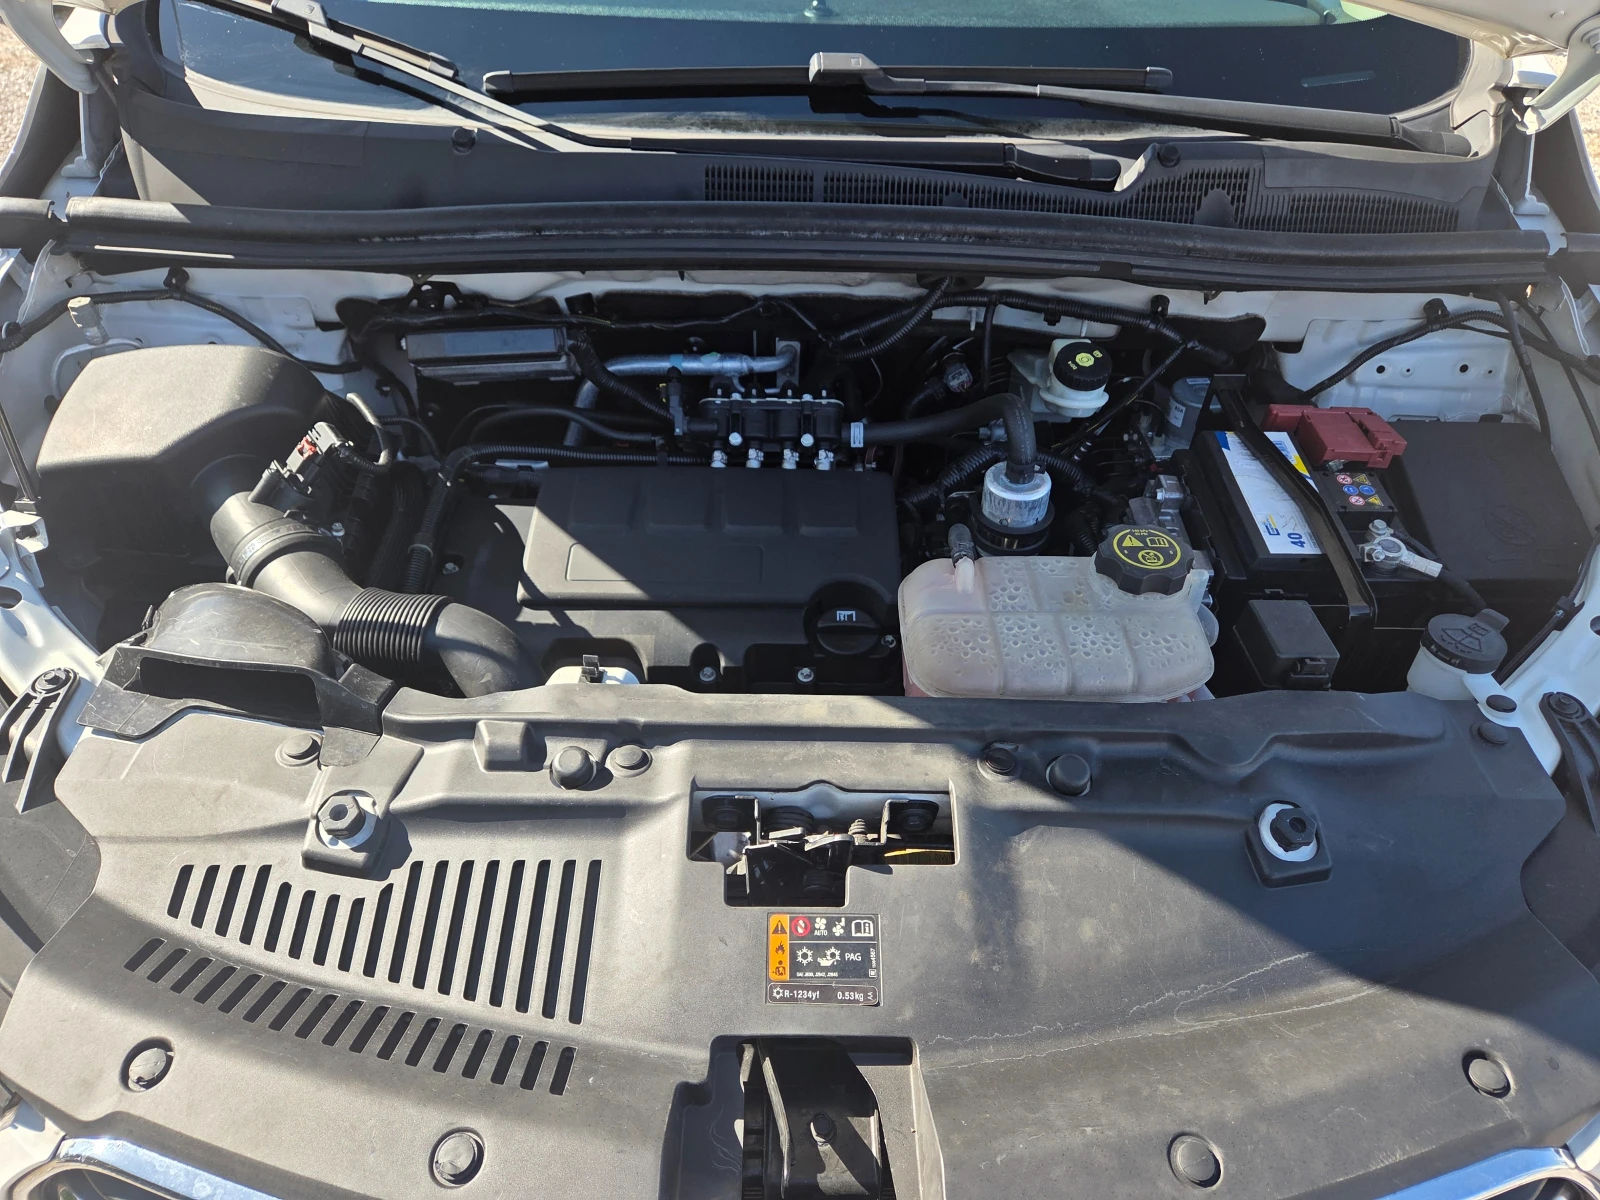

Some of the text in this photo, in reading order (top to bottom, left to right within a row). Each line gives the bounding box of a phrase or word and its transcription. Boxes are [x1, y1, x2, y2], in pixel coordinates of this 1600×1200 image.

[1287, 533, 1306, 548] 40
[845, 953, 862, 961] PAG
[784, 990, 820, 1000] R-1234yf
